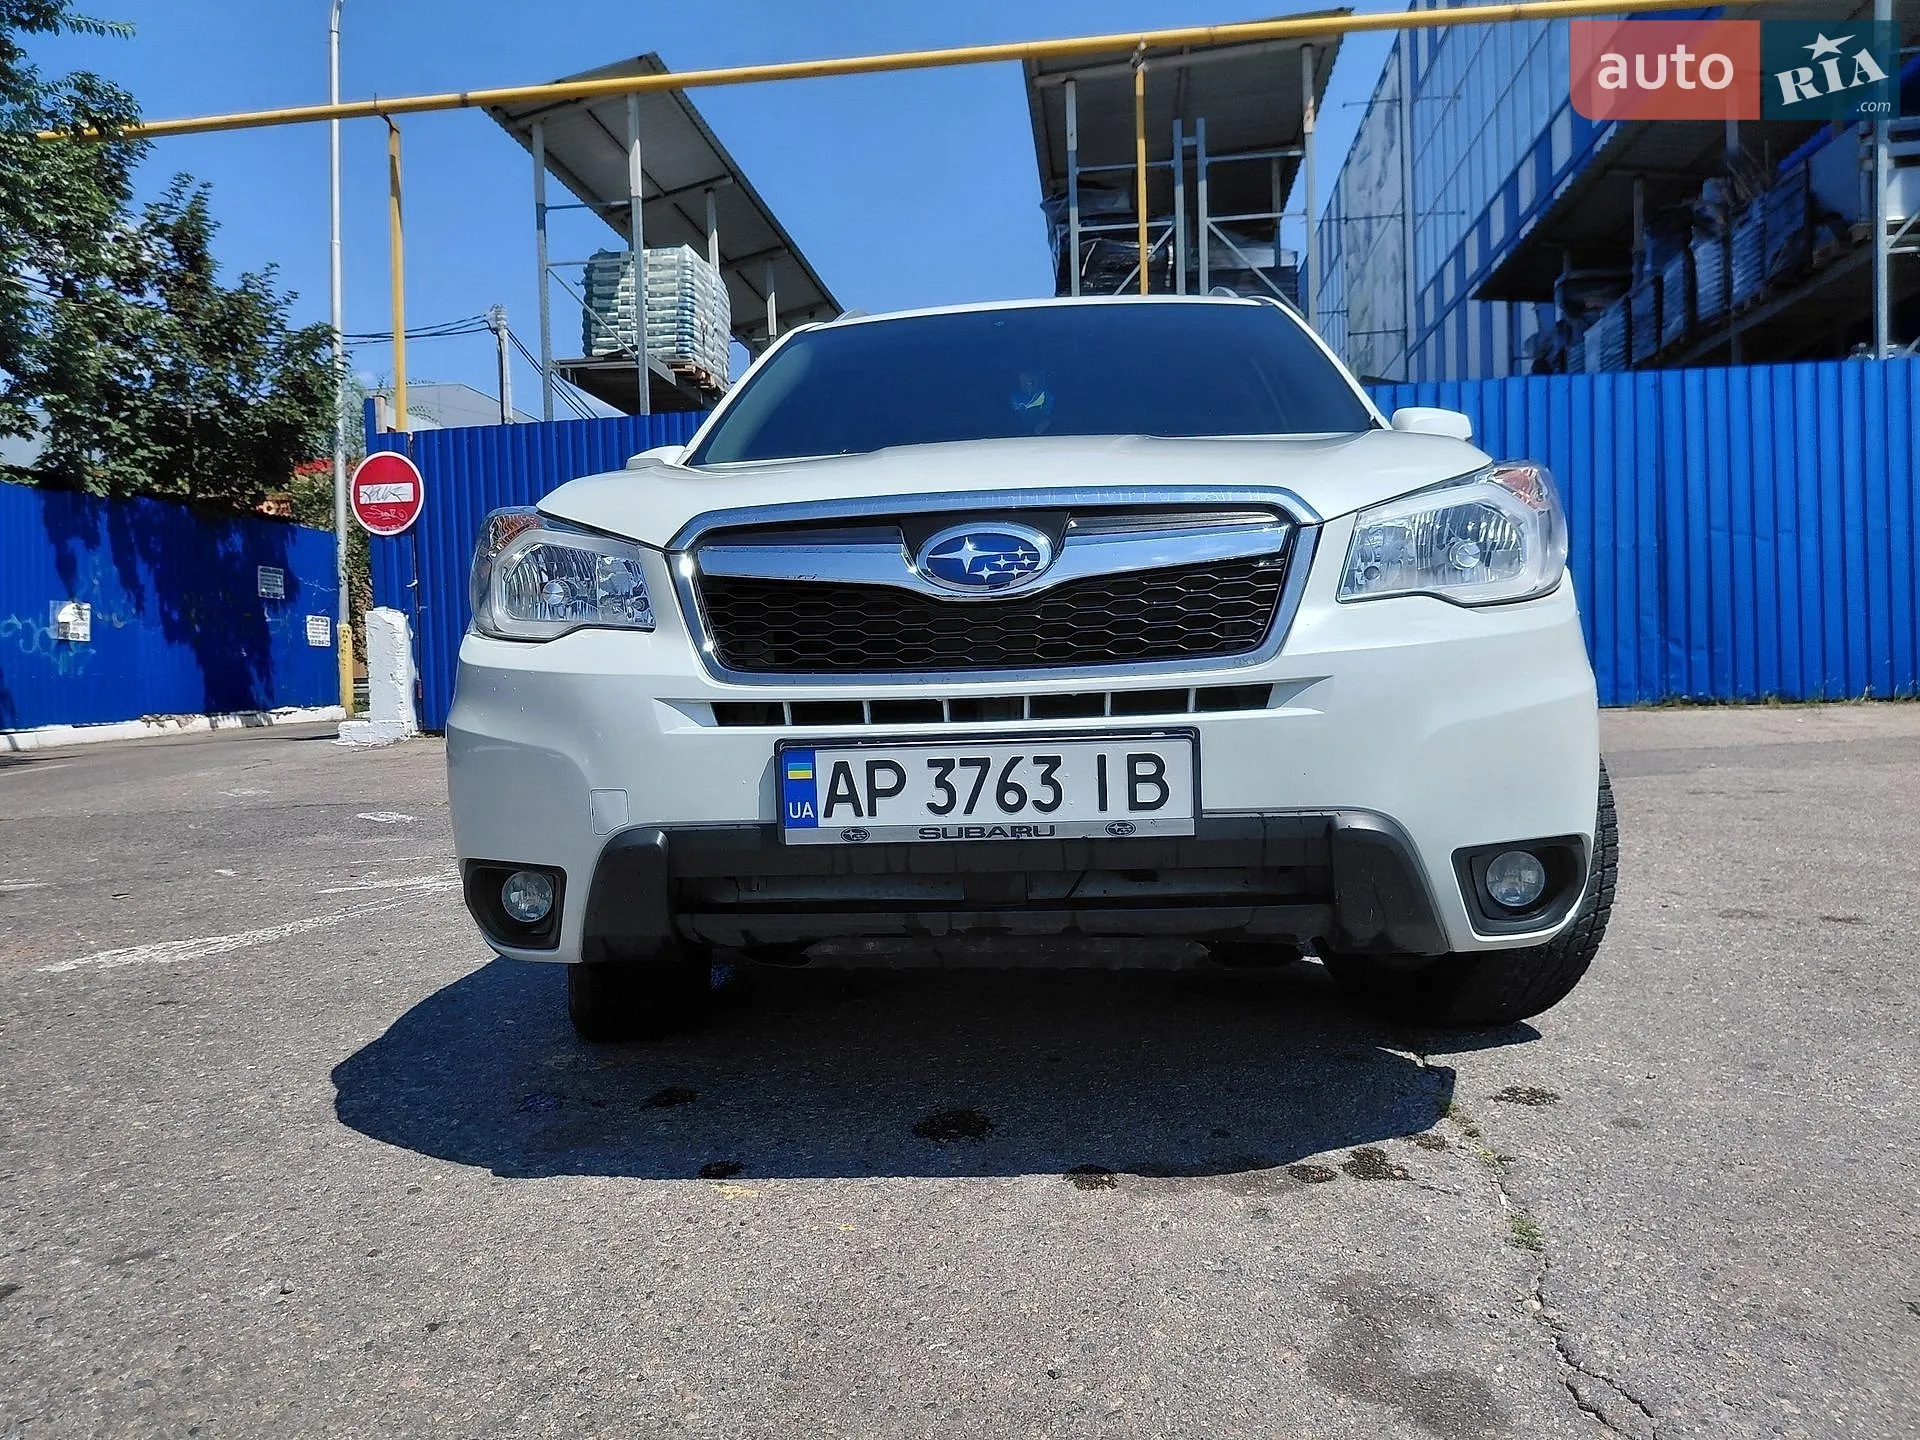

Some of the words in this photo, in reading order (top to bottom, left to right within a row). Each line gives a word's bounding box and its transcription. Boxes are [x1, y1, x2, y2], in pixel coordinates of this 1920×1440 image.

[823, 758, 907, 818] AP
[926, 755, 1064, 816] 3763
[1097, 752, 1171, 813] IB
[789, 802, 815, 819] UA
[918, 824, 1056, 840] SUBARU
